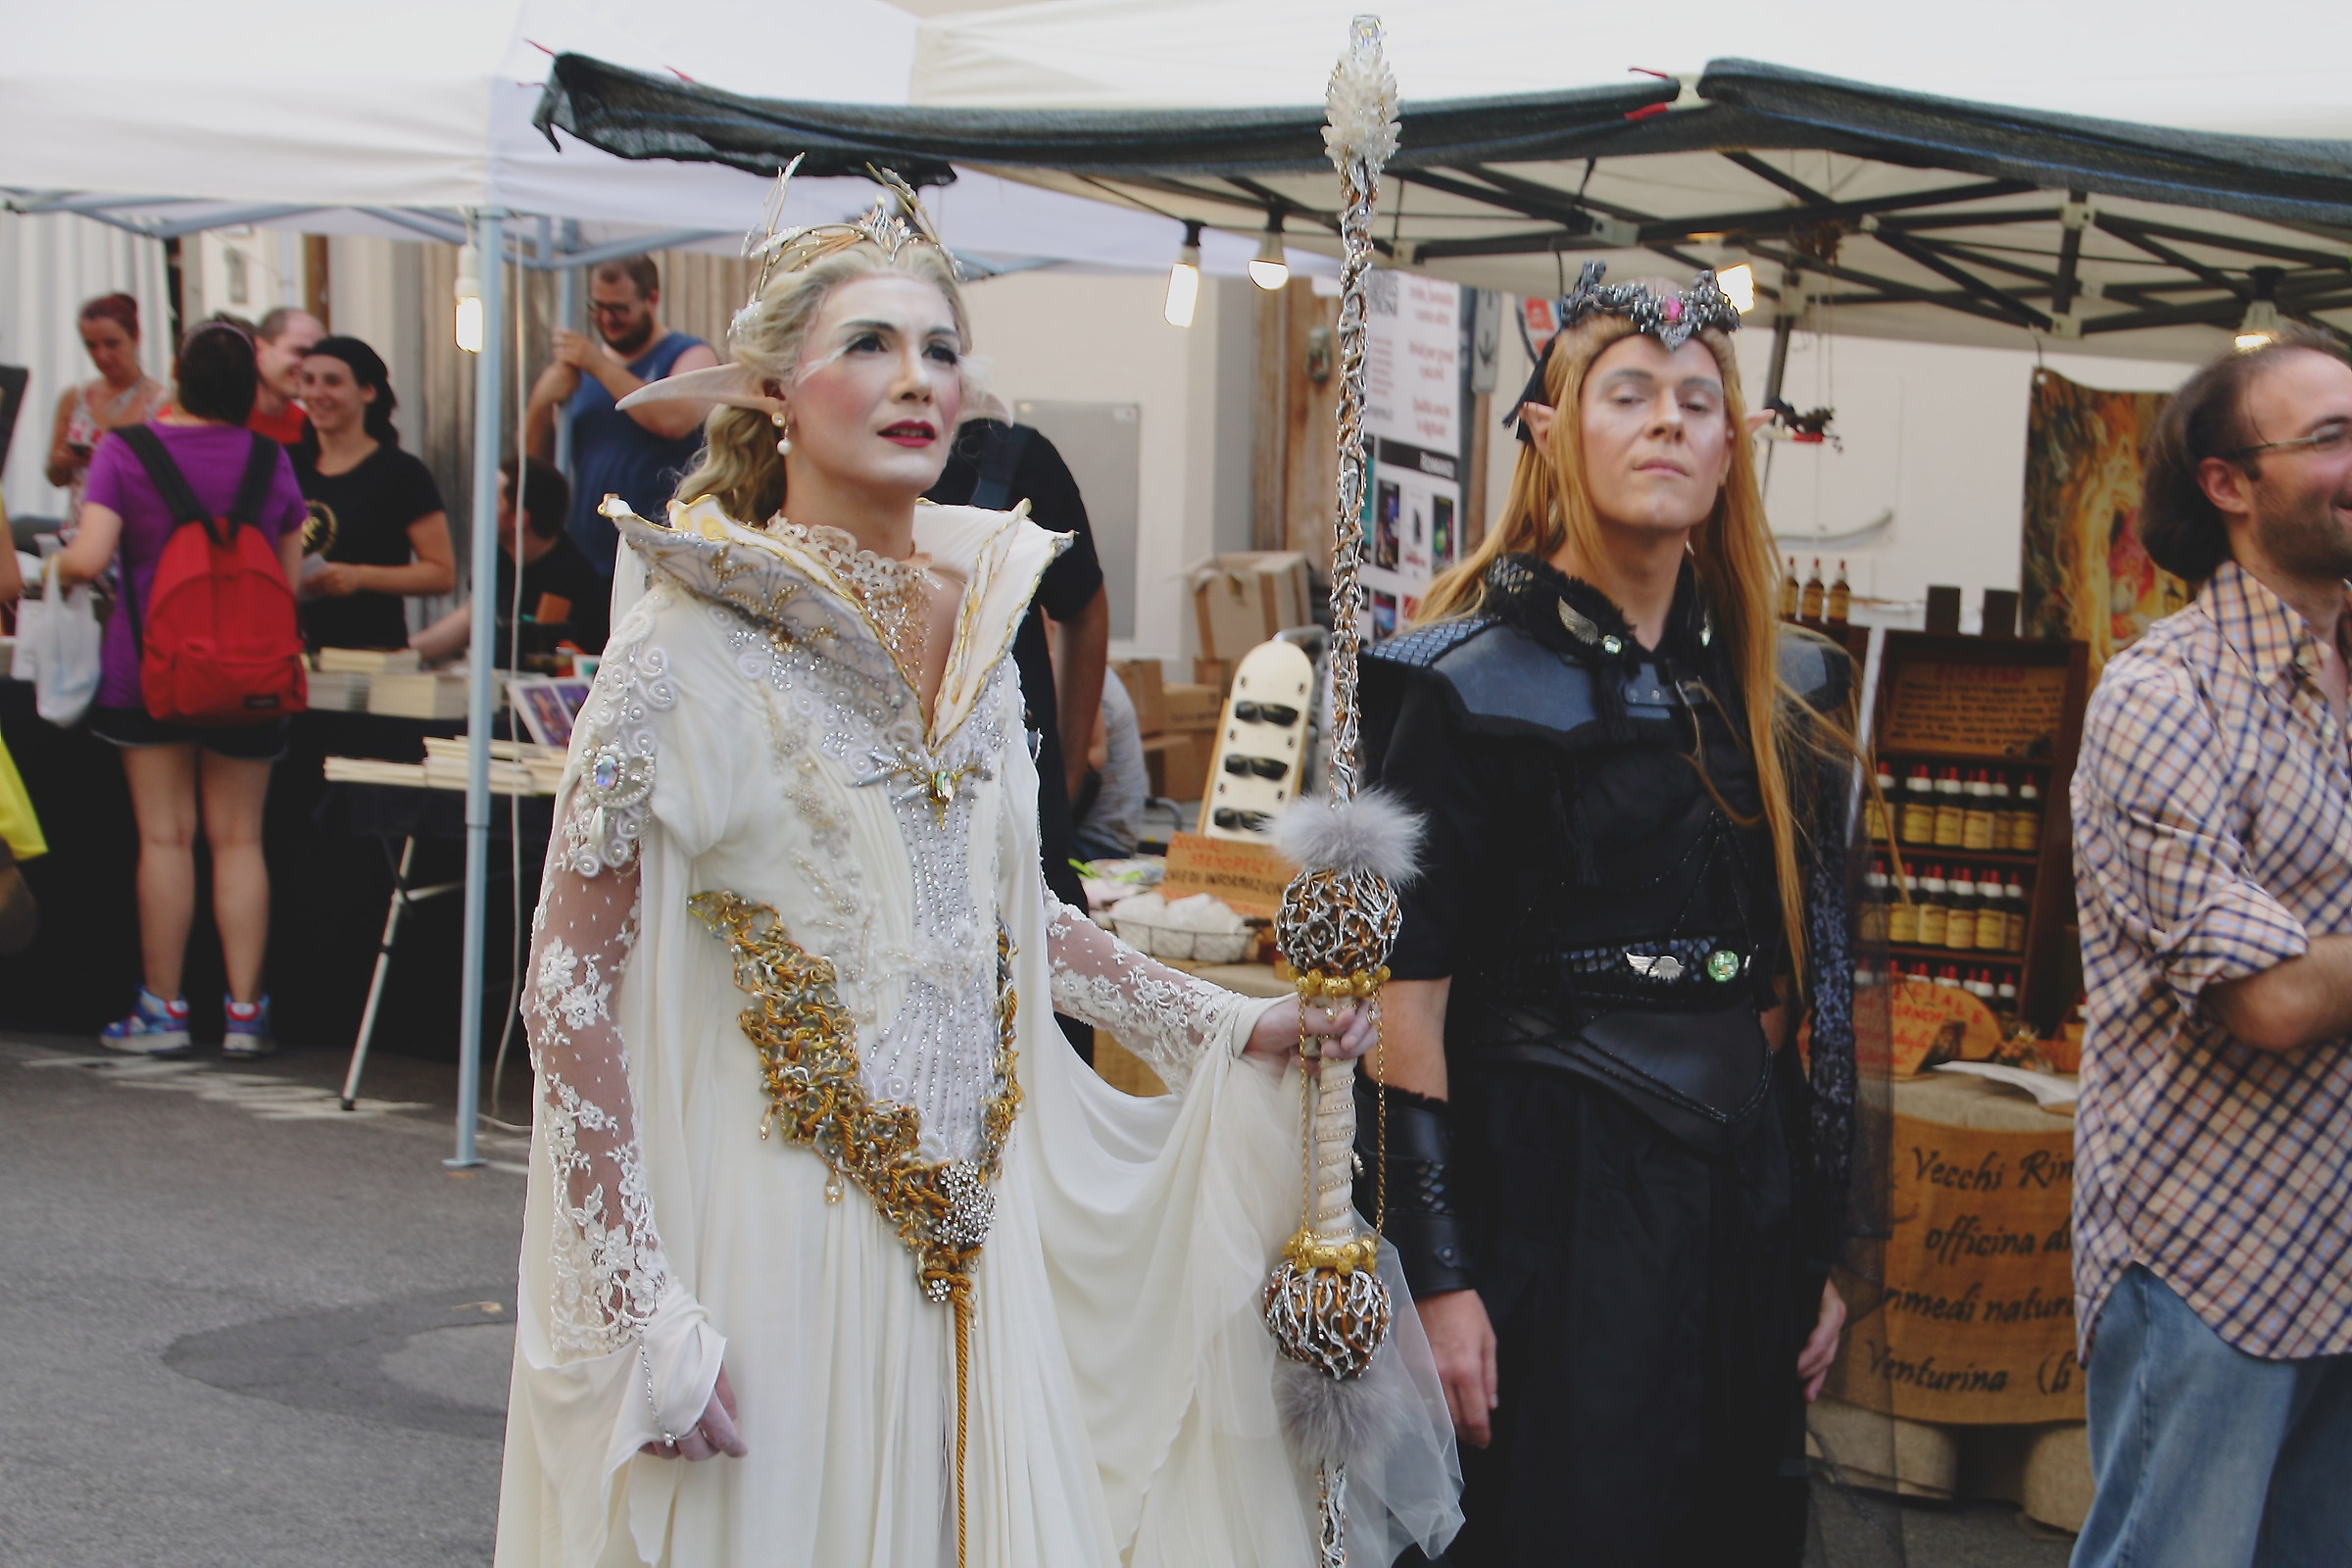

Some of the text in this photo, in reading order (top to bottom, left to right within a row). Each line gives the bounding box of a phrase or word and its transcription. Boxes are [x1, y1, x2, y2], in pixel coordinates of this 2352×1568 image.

[1203, 871, 1284, 896] INFORMAZION
[1912, 1146, 2006, 1193] Vecchi
[1924, 1215, 2035, 1266] officina
